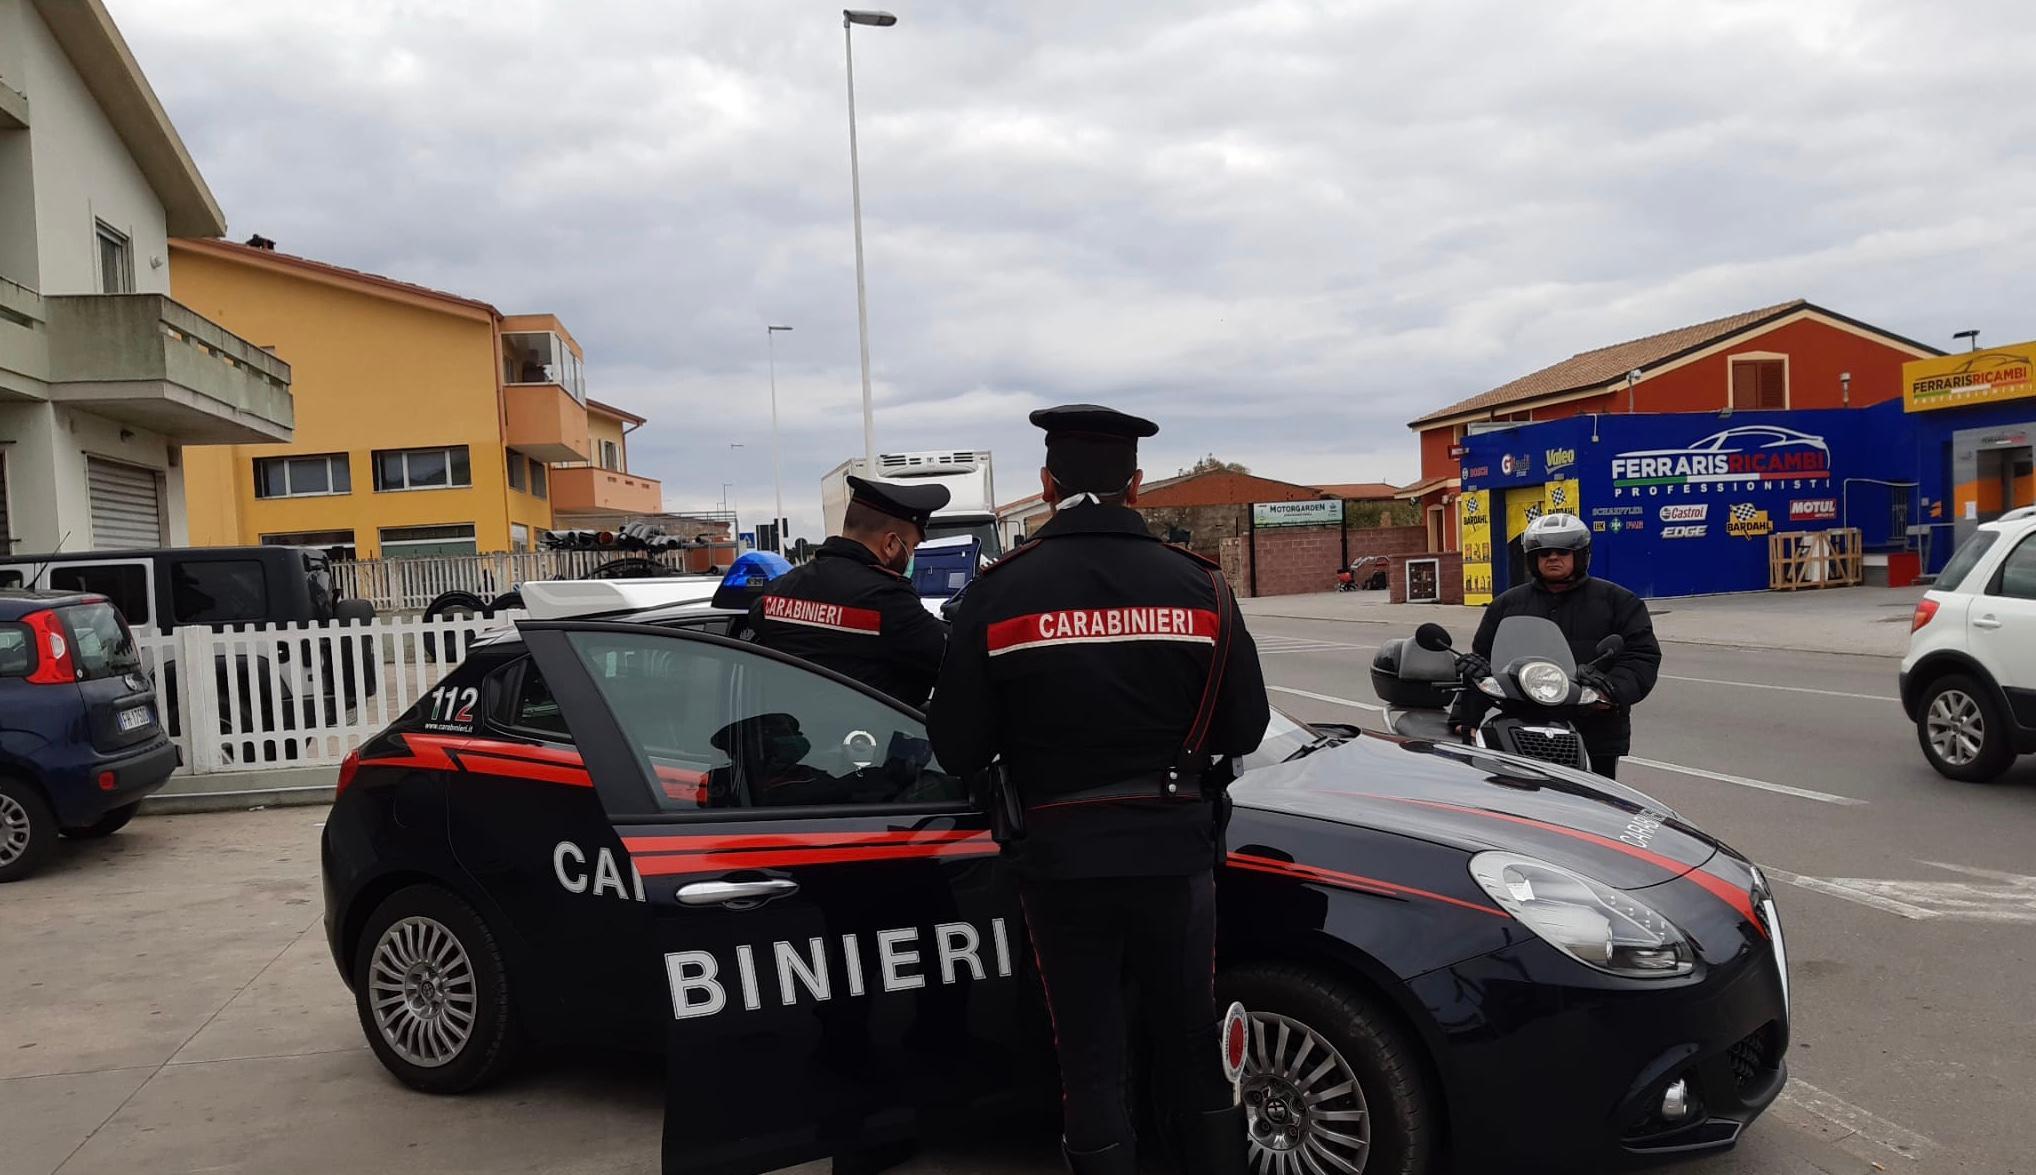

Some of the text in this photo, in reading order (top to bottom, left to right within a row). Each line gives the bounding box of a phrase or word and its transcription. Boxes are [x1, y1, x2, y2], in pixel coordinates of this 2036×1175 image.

[1546, 448, 1575, 467] Valeo
[1614, 480, 1830, 497] PROFESSIONISTI
[1269, 503, 1325, 513] MOTORGARDEN
[1671, 507, 1705, 519] Castrol
[1792, 501, 1836, 513] MOTUL
[1463, 515, 1489, 526] BARDAHL
[1727, 520, 1772, 532] BARDAHL
[1660, 525, 1708, 539] EDGE
[765, 597, 842, 626] CARABINIERI
[1038, 608, 1193, 638] CARABINIERI
[431, 686, 479, 722] 112
[664, 918, 1012, 1020] BINIERI
